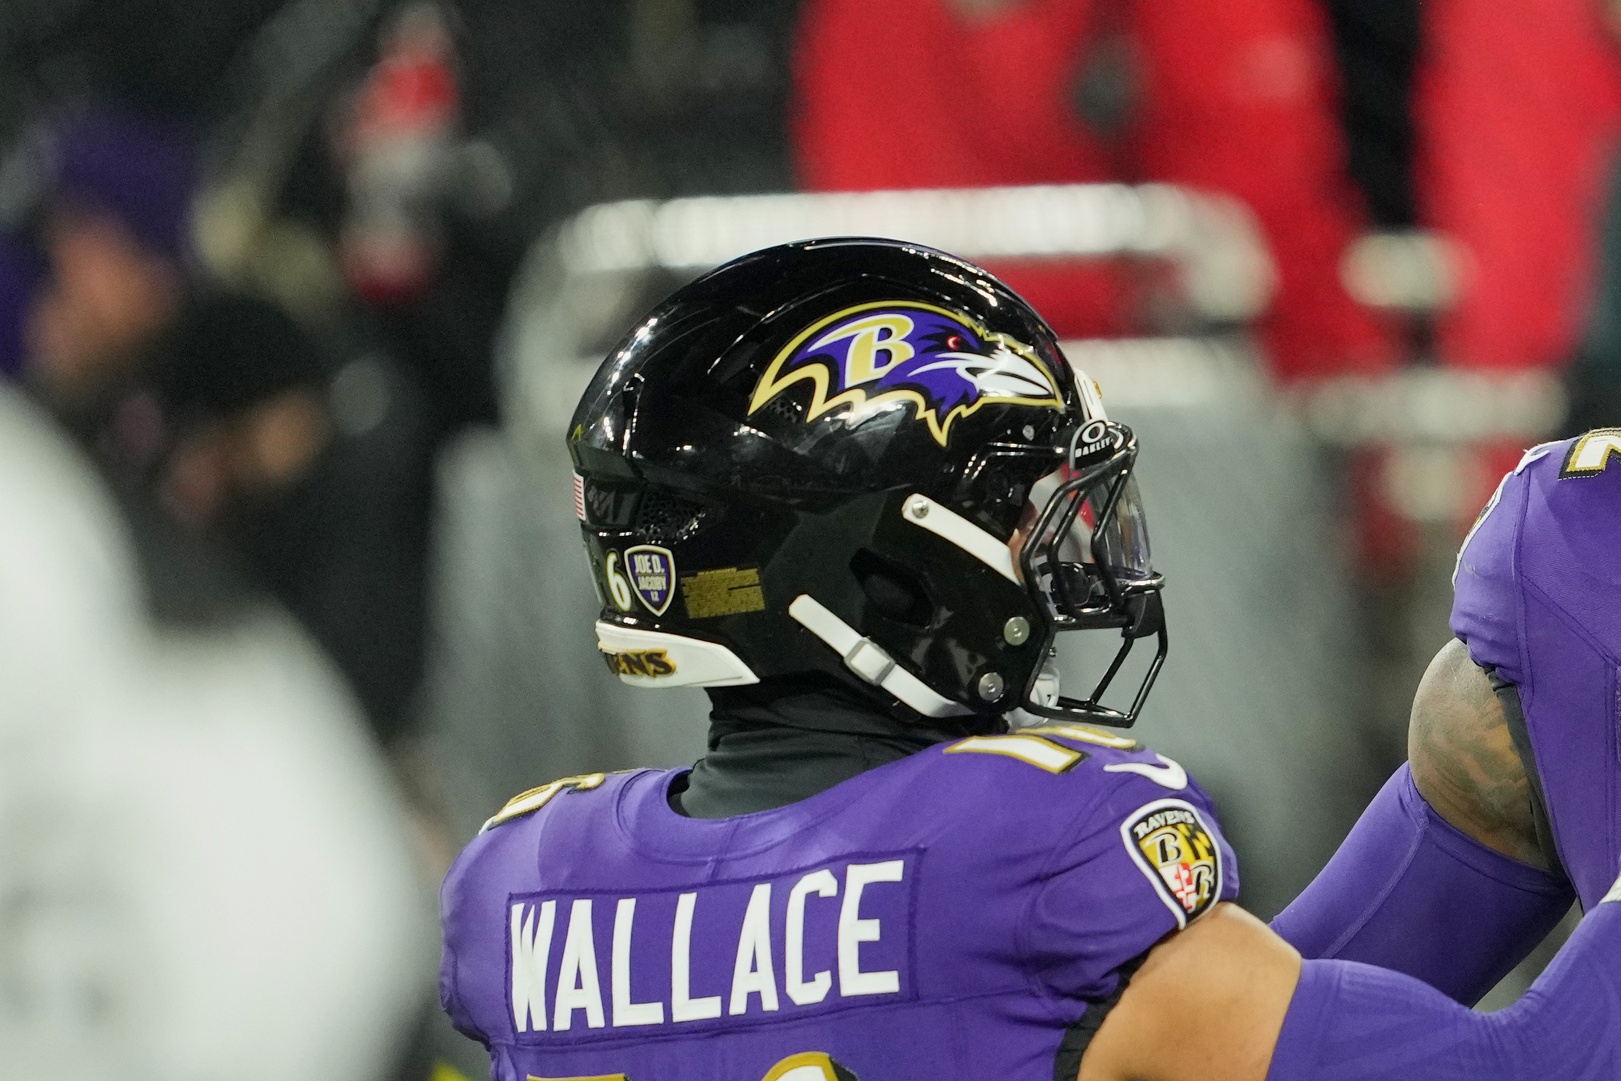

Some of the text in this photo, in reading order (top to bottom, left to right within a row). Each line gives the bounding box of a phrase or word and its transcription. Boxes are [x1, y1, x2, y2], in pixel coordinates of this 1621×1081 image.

[1075, 436, 1112, 458] OAKLEY
[634, 554, 652, 574] JOE
[1134, 810, 1196, 839] RAVENS
[511, 859, 905, 1033] WALLACE
